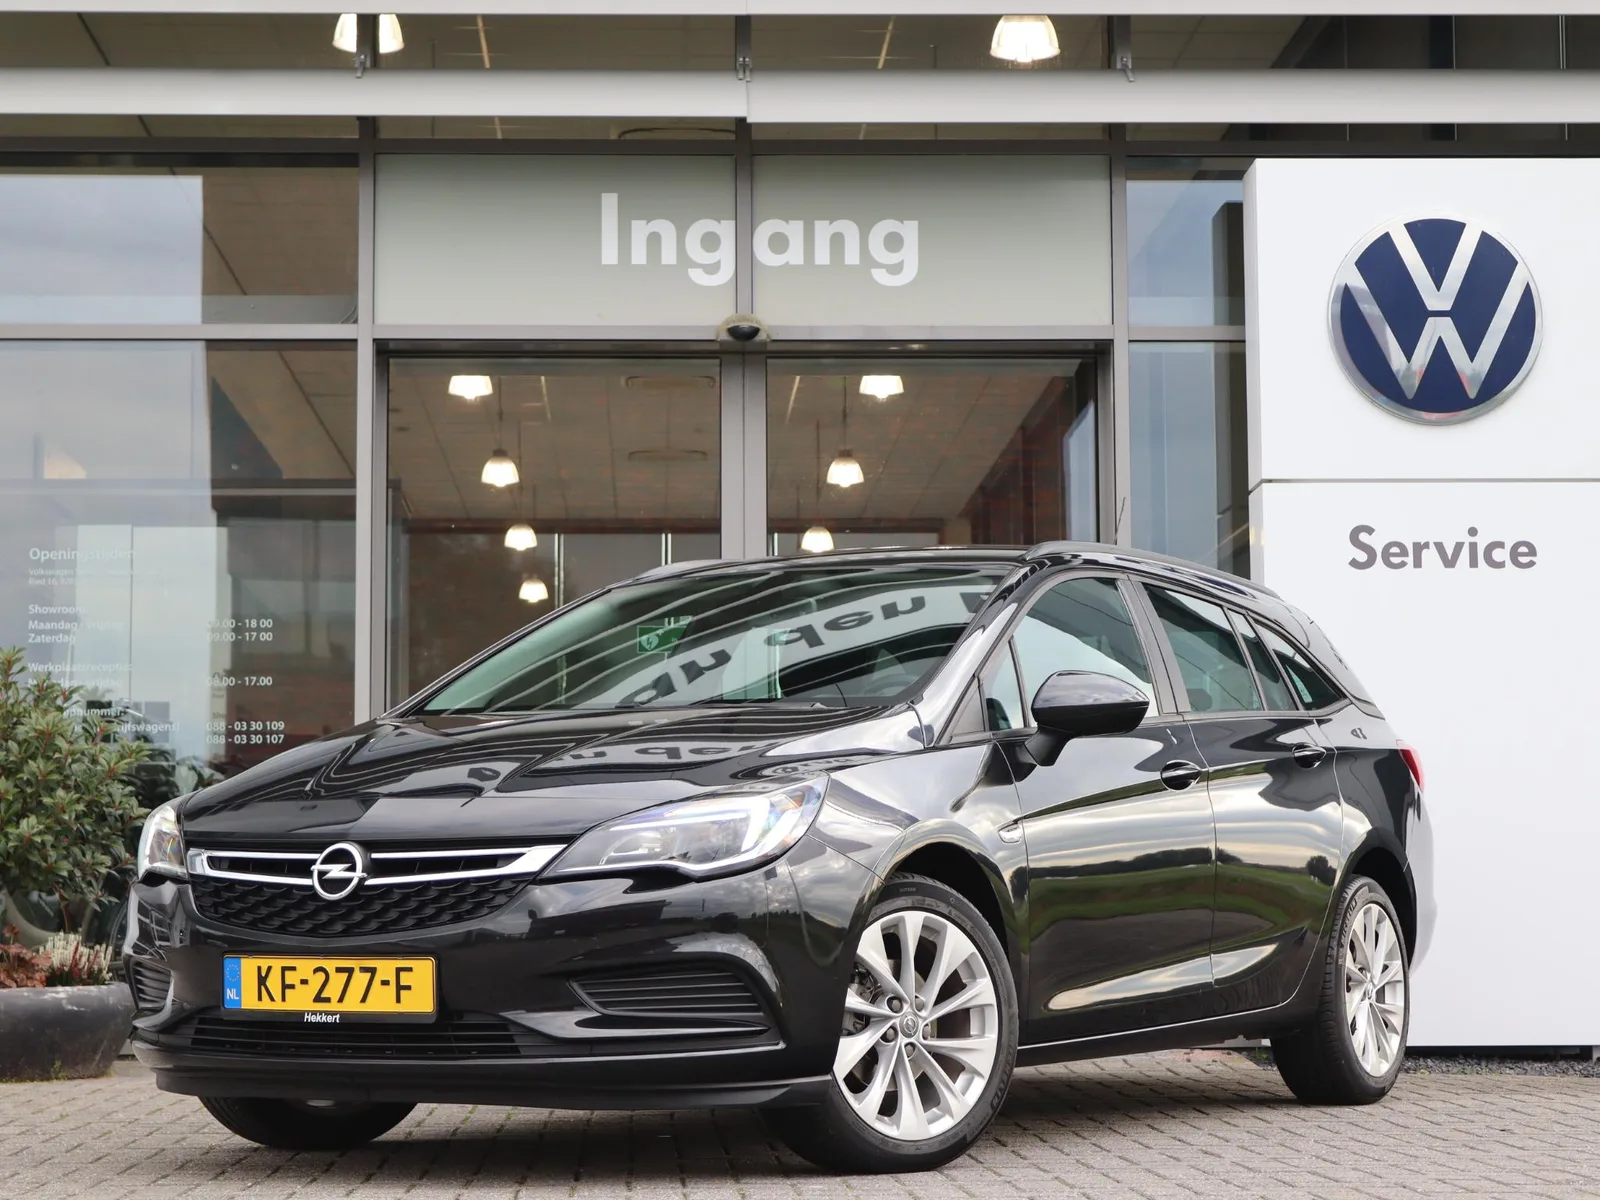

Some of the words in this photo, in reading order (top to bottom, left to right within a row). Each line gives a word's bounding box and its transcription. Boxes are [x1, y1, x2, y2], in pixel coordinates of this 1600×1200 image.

[601, 192, 919, 287] Ingang
[1348, 524, 1538, 571] Service
[28, 633, 76, 644] Zaterdag
[244, 676, 274, 687] 17.00
[233, 720, 247, 731] 03
[249, 720, 263, 731] 30
[266, 720, 285, 731] 109
[233, 734, 247, 745] 03
[249, 734, 263, 745] 30
[266, 734, 285, 745] 107
[256, 965, 414, 1004] KF-277-F
[226, 988, 240, 1000] NL
[303, 1012, 341, 1023] Hekkert
